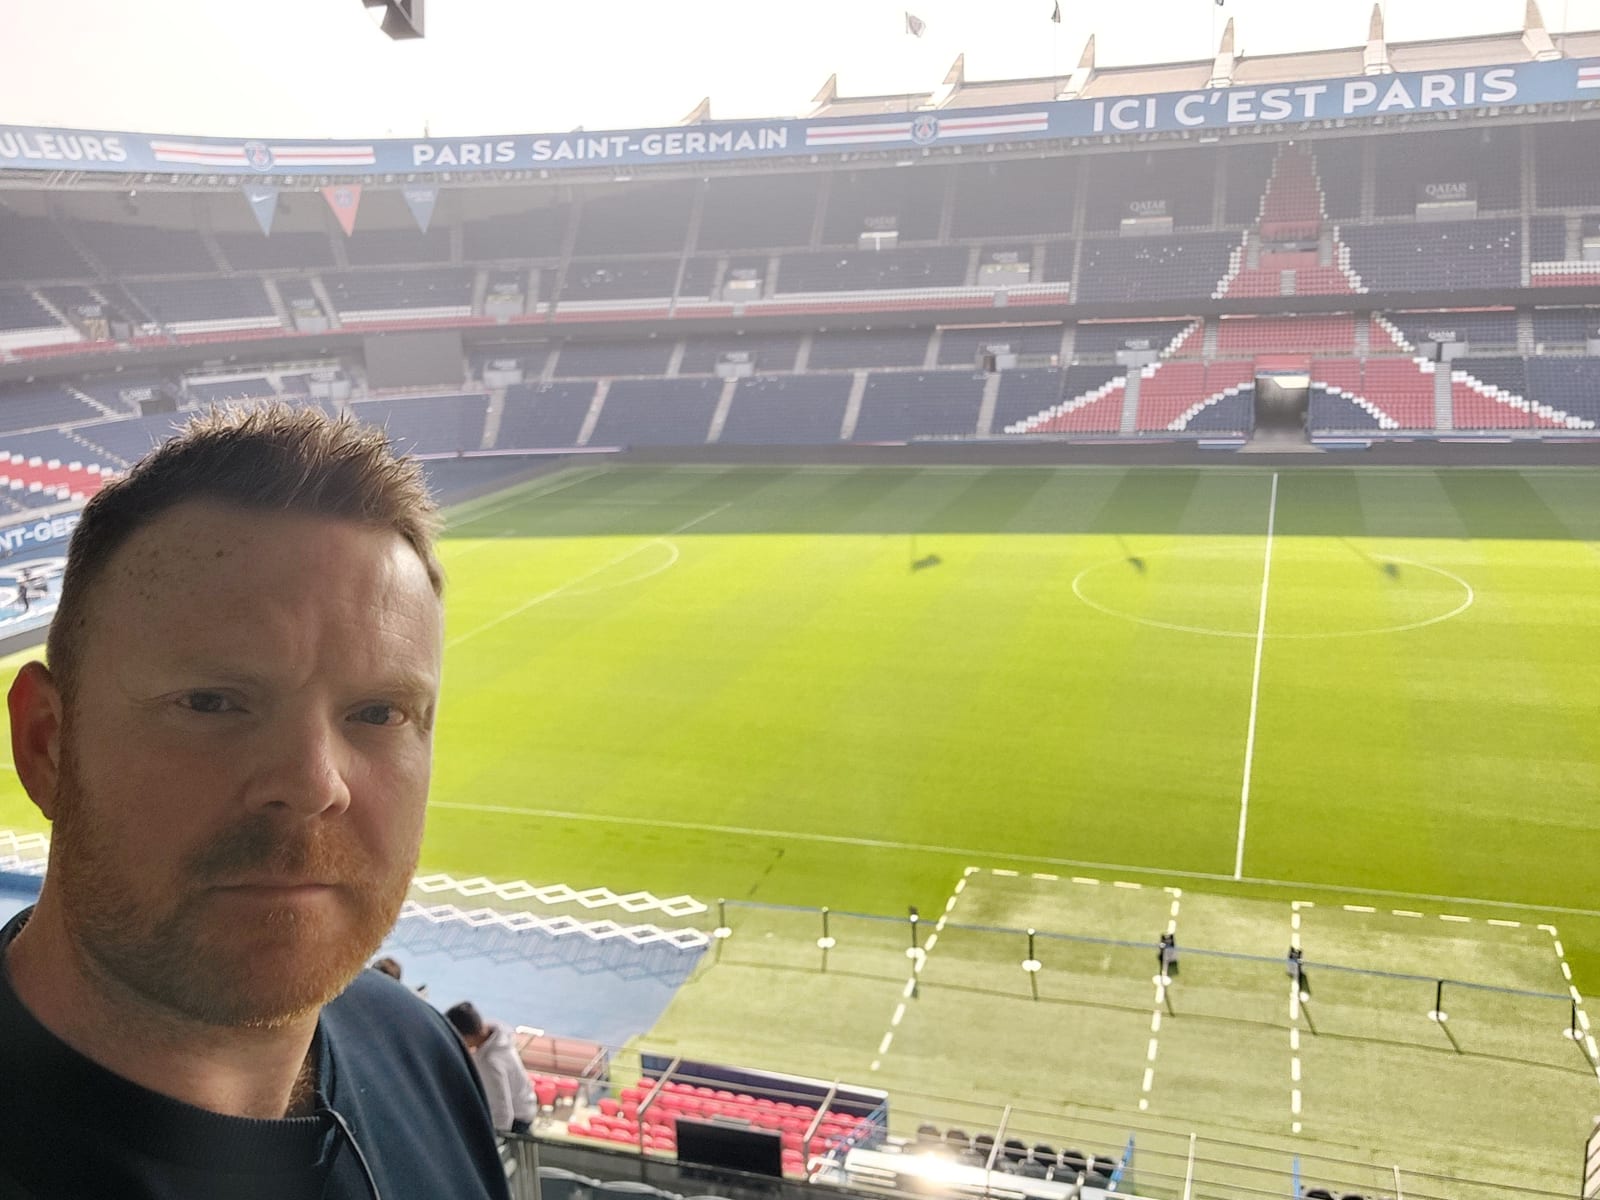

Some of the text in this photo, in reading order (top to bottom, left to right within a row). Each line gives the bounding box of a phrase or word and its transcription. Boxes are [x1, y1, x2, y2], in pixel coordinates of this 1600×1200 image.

[1093, 68, 1518, 132] ICI C'EST PARIS
[413, 127, 788, 167] PARIS SAINT-GERMAIN
[1425, 182, 1468, 195] QATAR
[1129, 200, 1166, 211] QATAR
